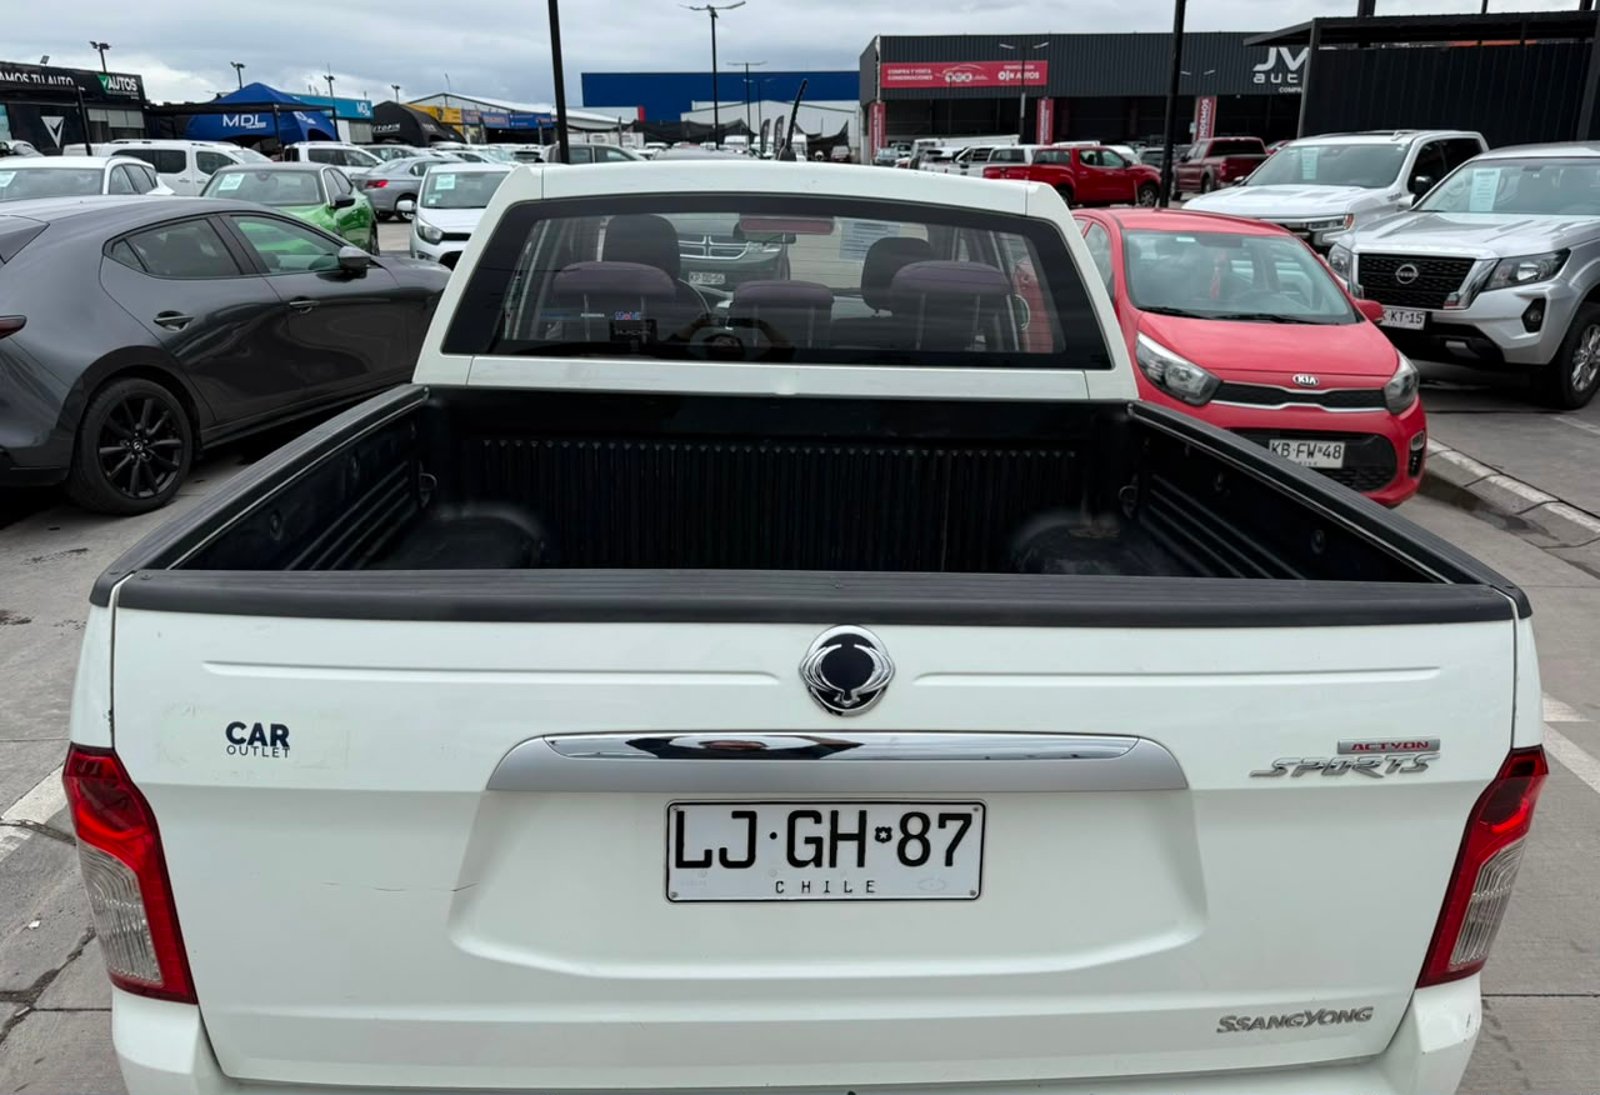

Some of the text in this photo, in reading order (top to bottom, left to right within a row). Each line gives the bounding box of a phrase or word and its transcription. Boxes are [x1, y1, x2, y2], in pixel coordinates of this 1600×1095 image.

[1298, 375, 1317, 386] KIA
[225, 721, 290, 748] CAR
[226, 744, 290, 759] OUTLET
[1351, 740, 1430, 751] ACTYON
[1249, 752, 1441, 778] SPORTS
[774, 880, 876, 895] CHILE
[1216, 1006, 1375, 1034] SSANGYONG
